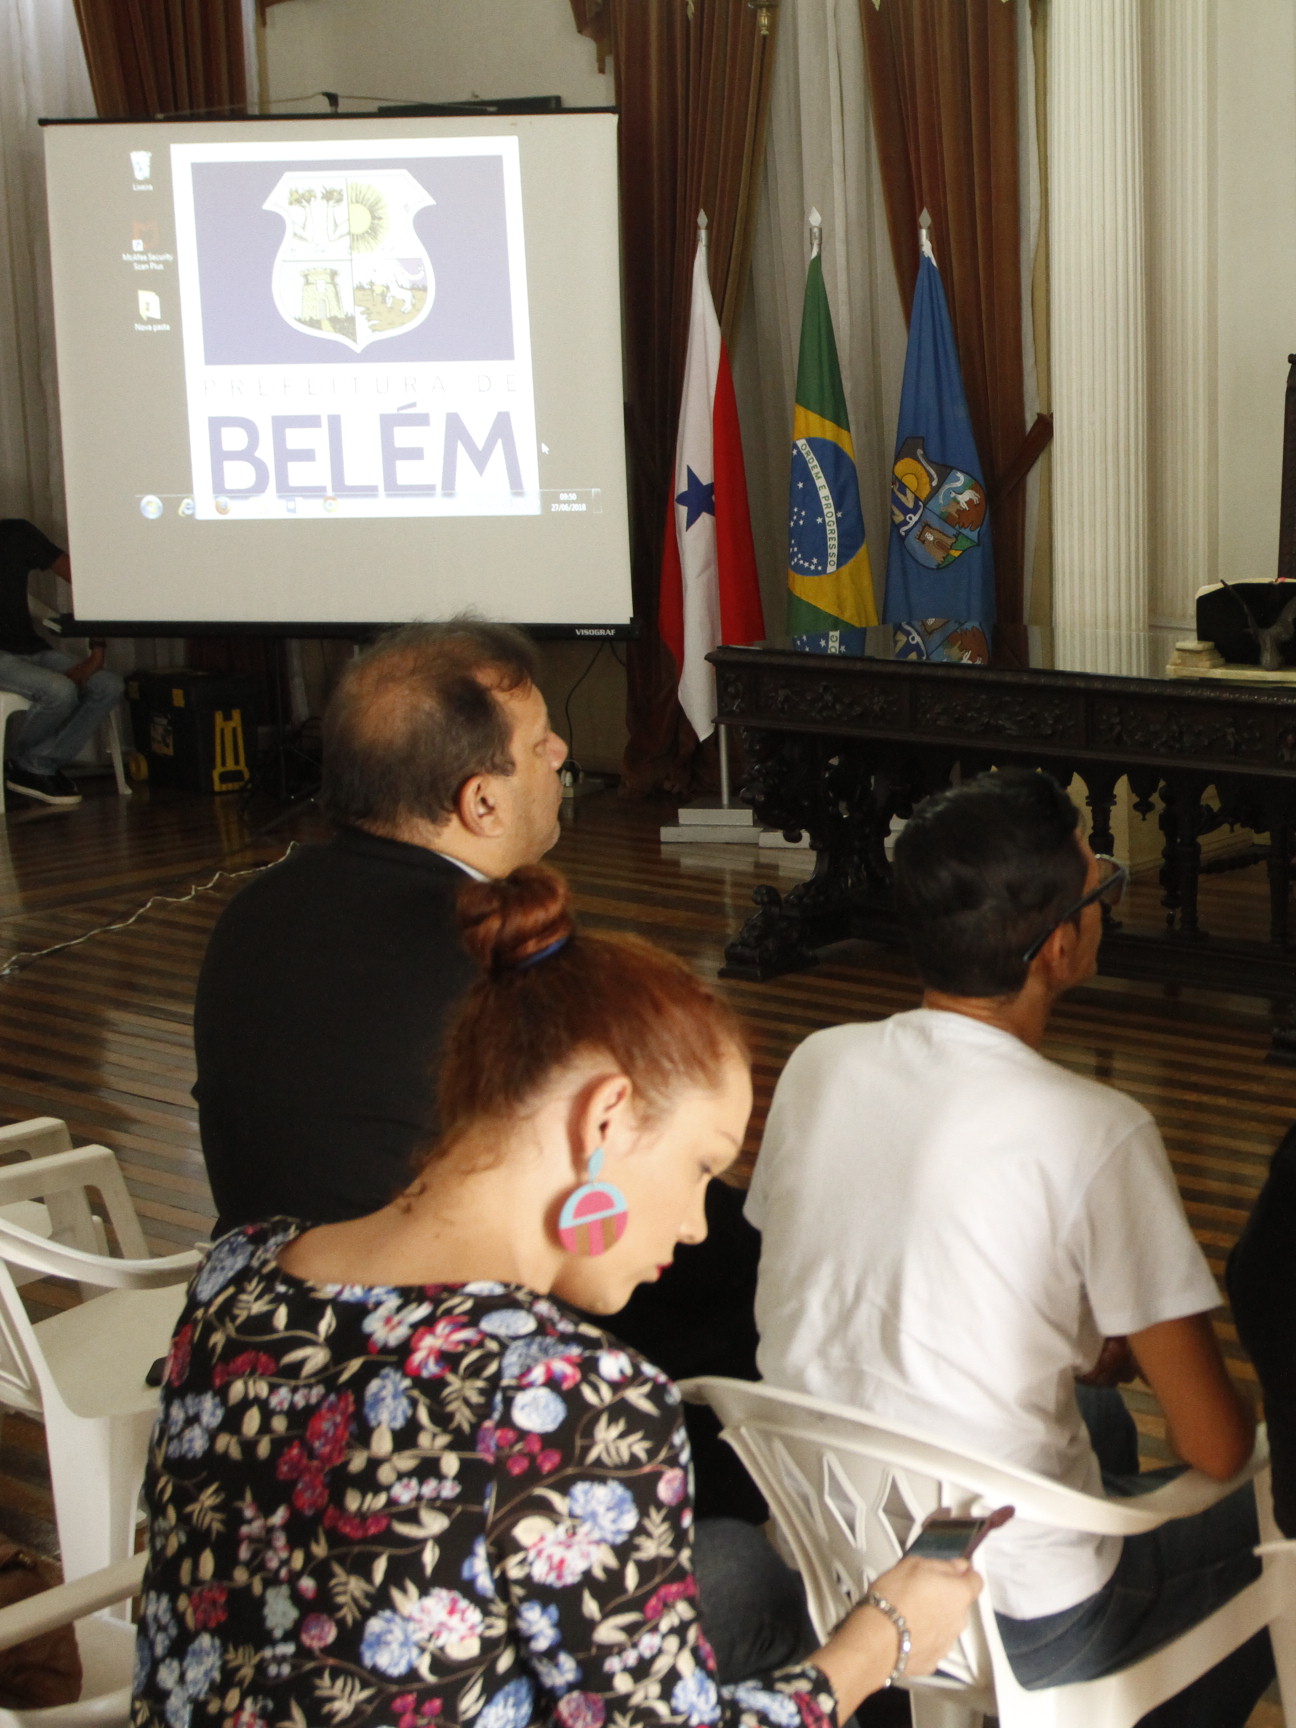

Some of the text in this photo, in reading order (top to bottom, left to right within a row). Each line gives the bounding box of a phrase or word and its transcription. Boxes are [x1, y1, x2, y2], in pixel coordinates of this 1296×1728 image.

[203, 373, 519, 398] PREFEITURA DE
[207, 401, 526, 499] BELÉM
[800, 443, 837, 567] ORDEM E PROGRESSO
[575, 628, 616, 636] VISOGRAF
